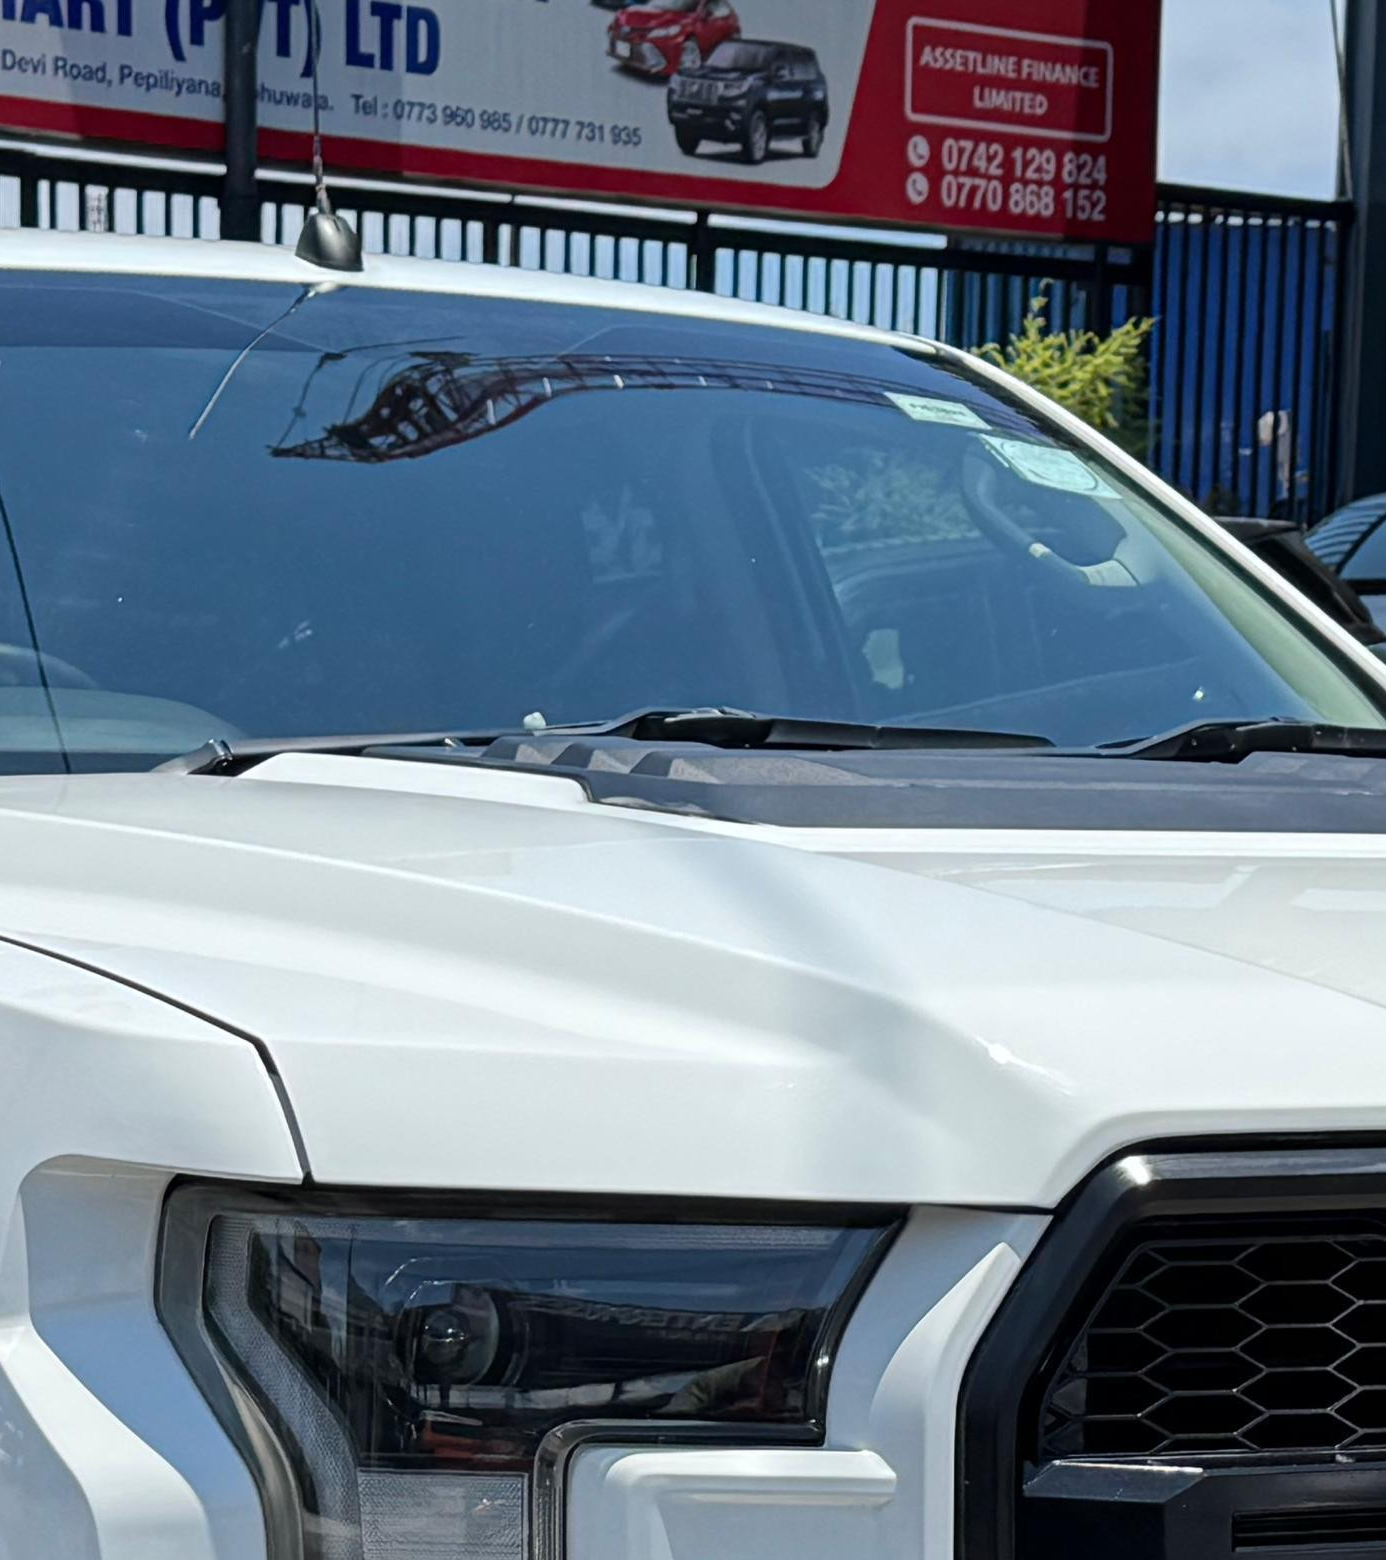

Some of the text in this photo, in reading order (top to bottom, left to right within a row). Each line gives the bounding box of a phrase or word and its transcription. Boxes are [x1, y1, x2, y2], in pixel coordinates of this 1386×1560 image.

[165, 0, 322, 78] (PT)
[345, 0, 440, 76] LTD
[920, 45, 1100, 88] ASSETLINE FINANCE
[1, 49, 46, 75] Devi
[53, 56, 112, 87] Road,
[256, 82, 334, 111] huwaa.
[393, 99, 437, 124] 0773
[442, 105, 475, 128] 960
[479, 110, 512, 132] 985
[528, 115, 570, 139] 0777
[575, 121, 604, 142] 731
[611, 125, 642, 146] 935
[973, 85, 1048, 116] LIMITED
[941, 138, 1107, 186] 0742 129 824
[940, 174, 1107, 221] 0770 868 152
